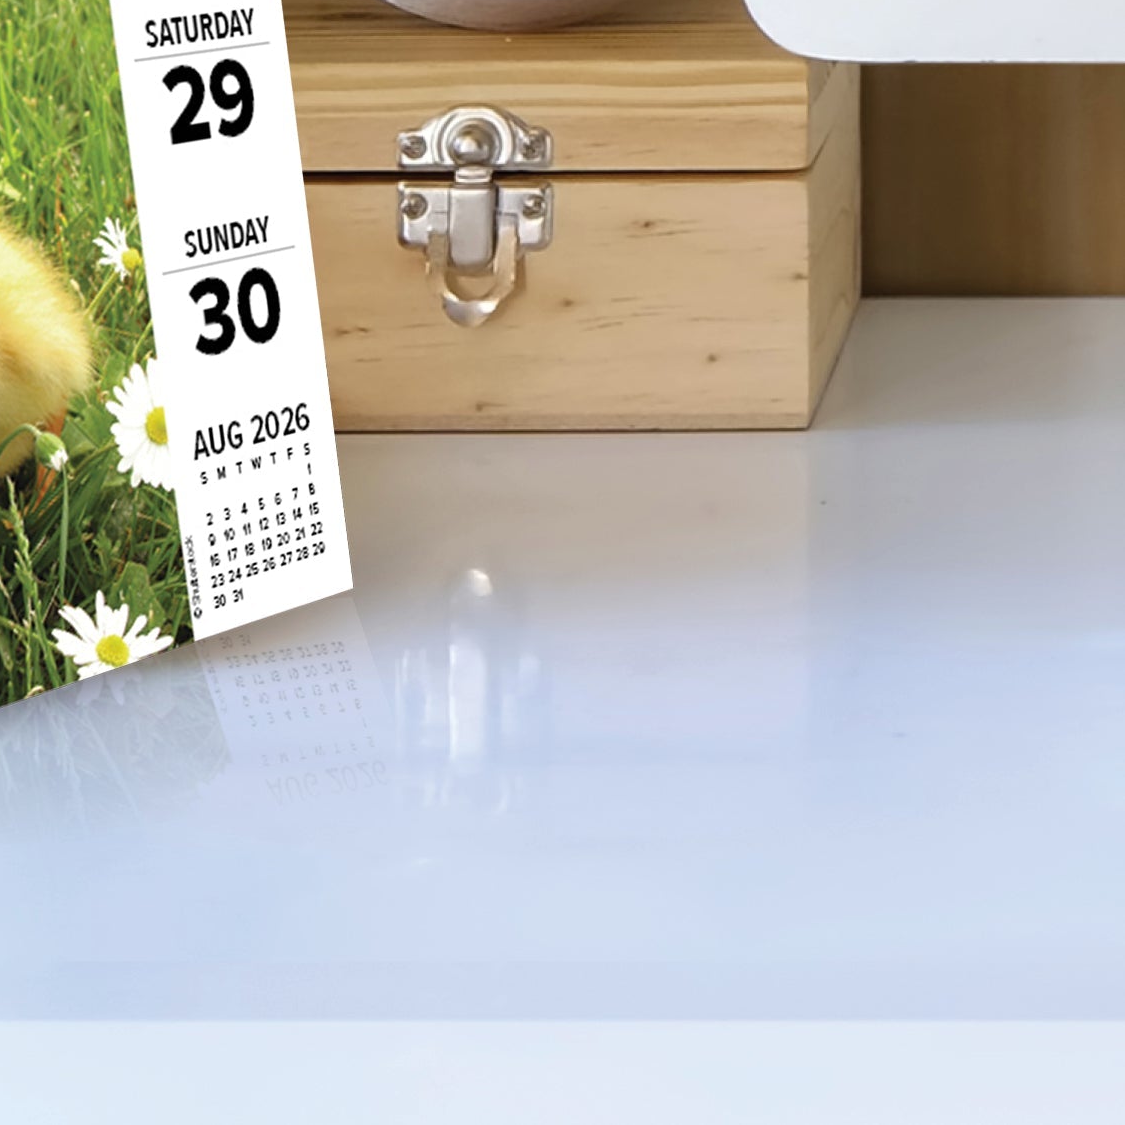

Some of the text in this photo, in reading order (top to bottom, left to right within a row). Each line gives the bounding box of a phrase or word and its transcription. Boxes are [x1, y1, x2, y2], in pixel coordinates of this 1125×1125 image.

[145, 7, 254, 48] SATURDAY
[162, 58, 255, 145] 29
[184, 215, 269, 258] SUNDAY
[188, 267, 281, 355] 30
[193, 402, 311, 461] AUG 2026
[199, 442, 311, 486] S M T W T F S
[306, 462, 312, 475] 1
[205, 482, 316, 527] 2 3 4 5 6 7 8
[207, 501, 320, 547] 9 10 11 12 13 14 15
[209, 521, 324, 568] 16 17 18 19 20 21 22
[210, 540, 326, 589] 23 24 25 26 27 28 29
[213, 587, 244, 610] 30 31
